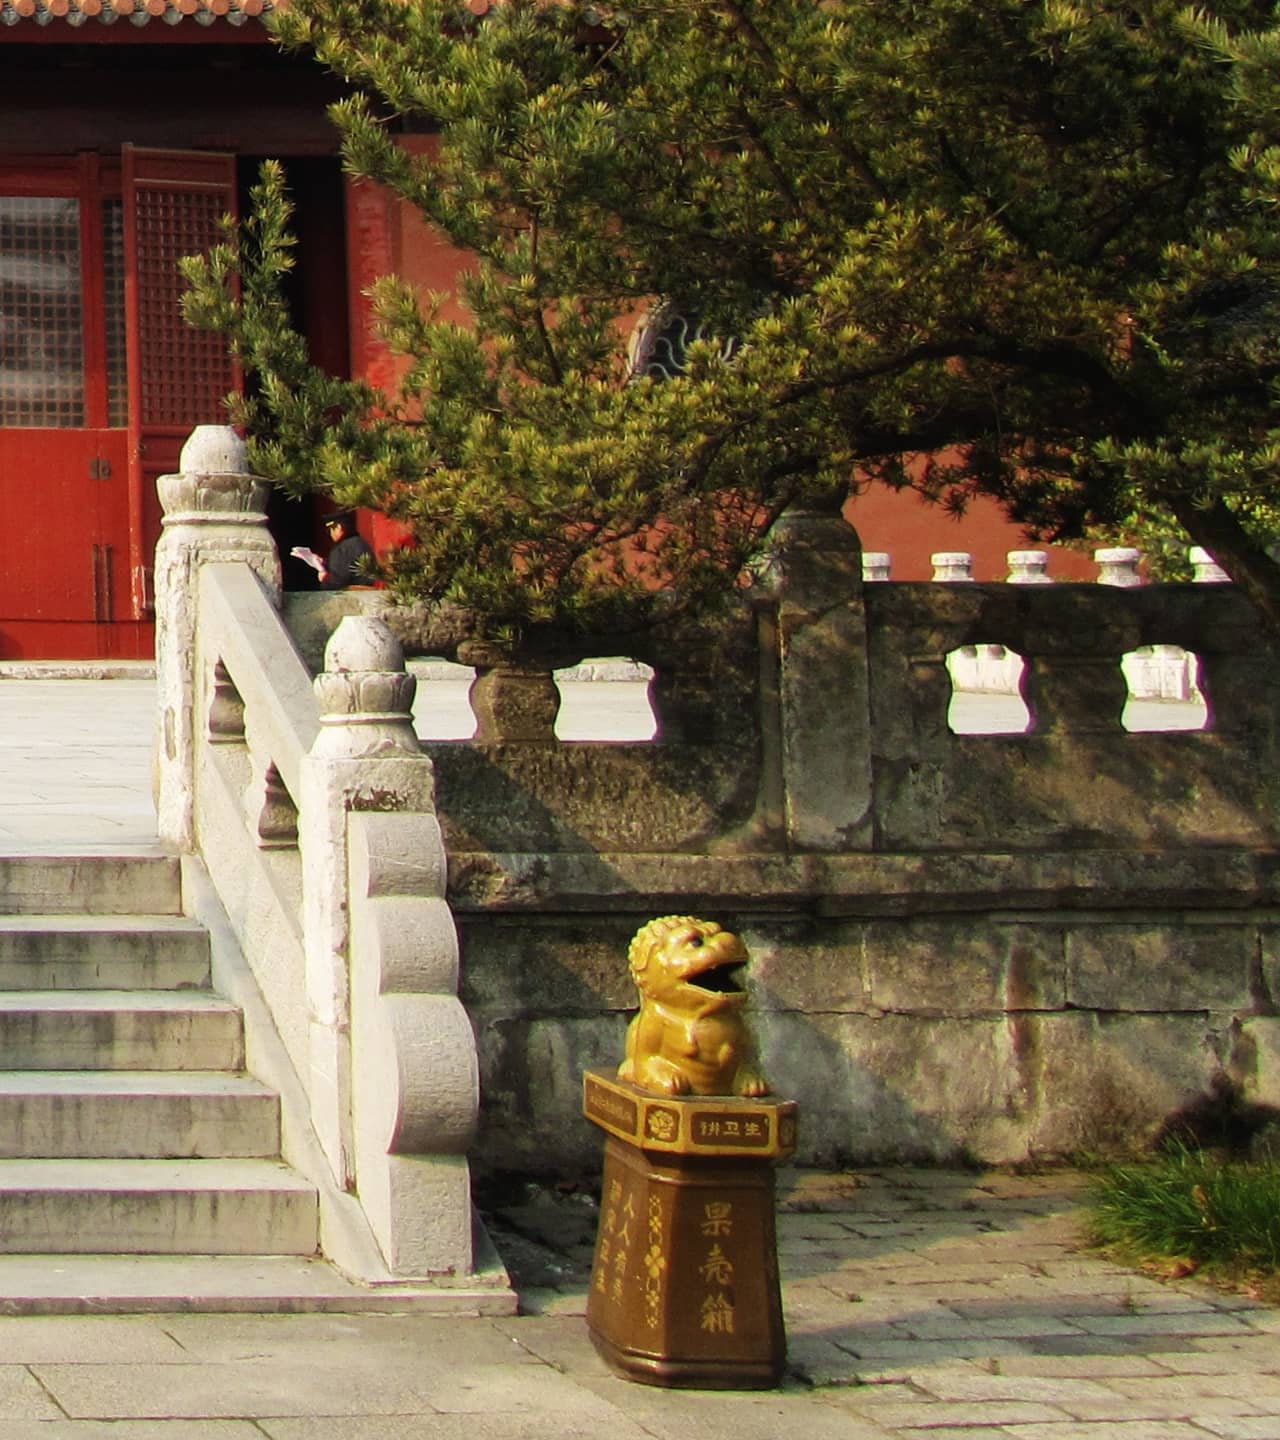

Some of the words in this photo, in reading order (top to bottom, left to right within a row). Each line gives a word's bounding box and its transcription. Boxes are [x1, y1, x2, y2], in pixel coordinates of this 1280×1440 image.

[701, 1121, 762, 1136] 讲卫生
[698, 1201, 736, 1334] 果壳箱
